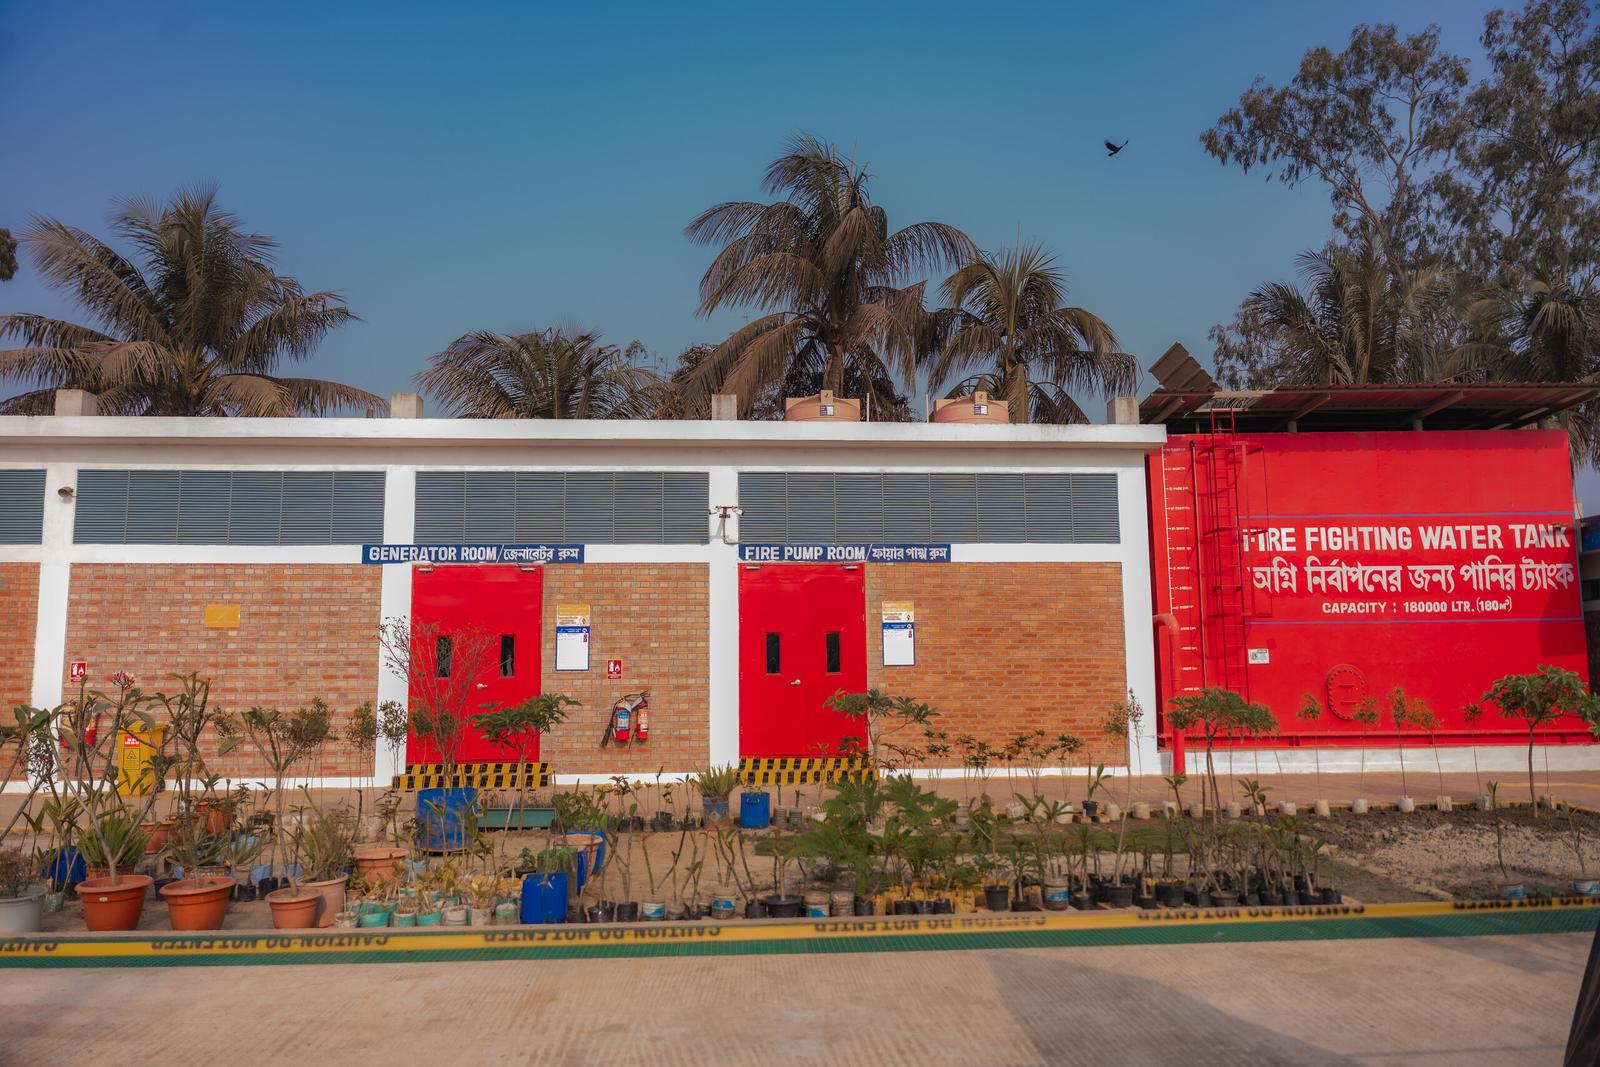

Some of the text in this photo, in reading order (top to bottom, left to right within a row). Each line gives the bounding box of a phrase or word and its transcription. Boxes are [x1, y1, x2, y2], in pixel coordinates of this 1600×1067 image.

[1242, 523, 1570, 552] FIRE FIGHTING WATER TANK
[369, 546, 457, 561] GENERATOR
[558, 548, 580, 561] রুম
[745, 546, 780, 560] FIRE
[784, 546, 824, 560] PUMP
[929, 547, 948, 560] রুম
[1247, 556, 1298, 593] অগ্নি
[1407, 563, 1455, 593] জন্য
[1459, 554, 1516, 591] পানির
[1519, 555, 1575, 591] ট্যাংক
[1322, 602, 1387, 614] CAPACITY
[1403, 601, 1447, 613] 180000
